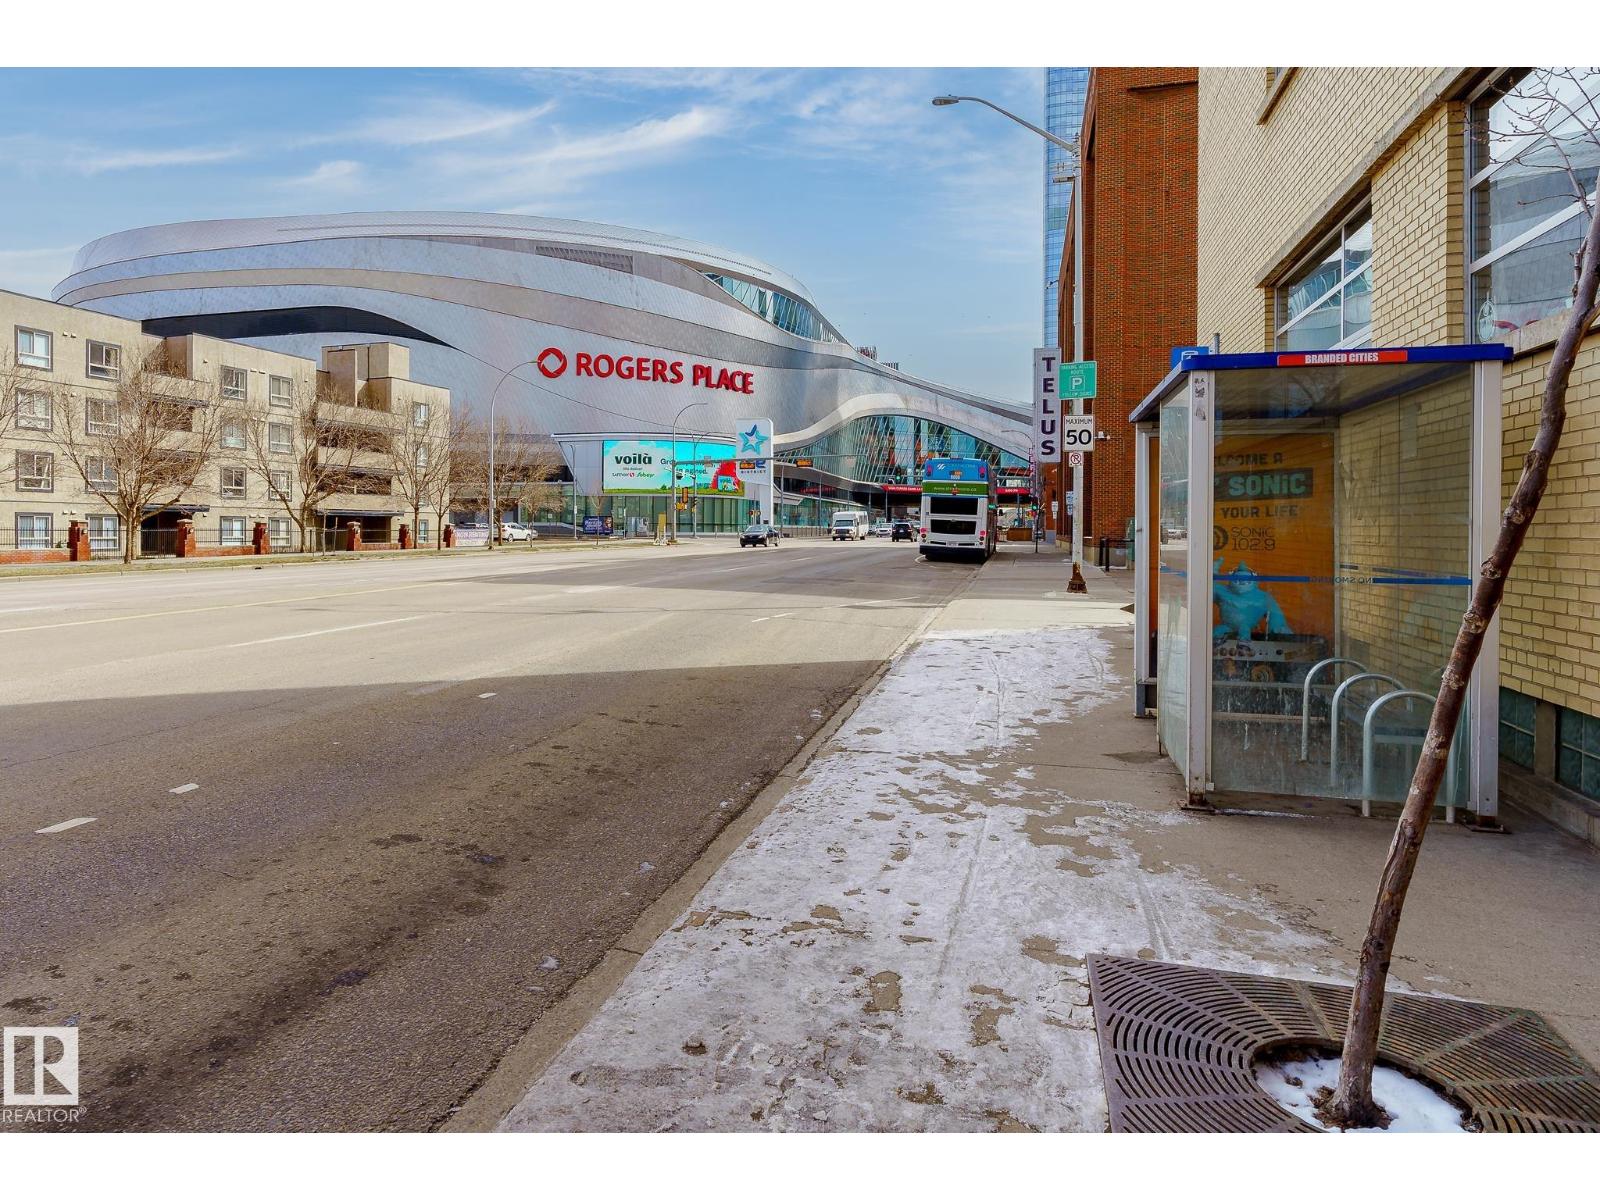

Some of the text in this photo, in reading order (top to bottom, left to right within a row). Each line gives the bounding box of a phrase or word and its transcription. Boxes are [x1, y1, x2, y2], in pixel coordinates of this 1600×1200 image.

[1305, 352, 1379, 364] BRANDED CITIES
[576, 352, 754, 394] ROGERS PLACE
[1041, 356, 1056, 455] TELUS
[1066, 429, 1092, 445] 50
[615, 453, 652, 465] voilà
[1221, 504, 1298, 519] YOUR LIFE
[1231, 538, 1276, 551] 102.9
